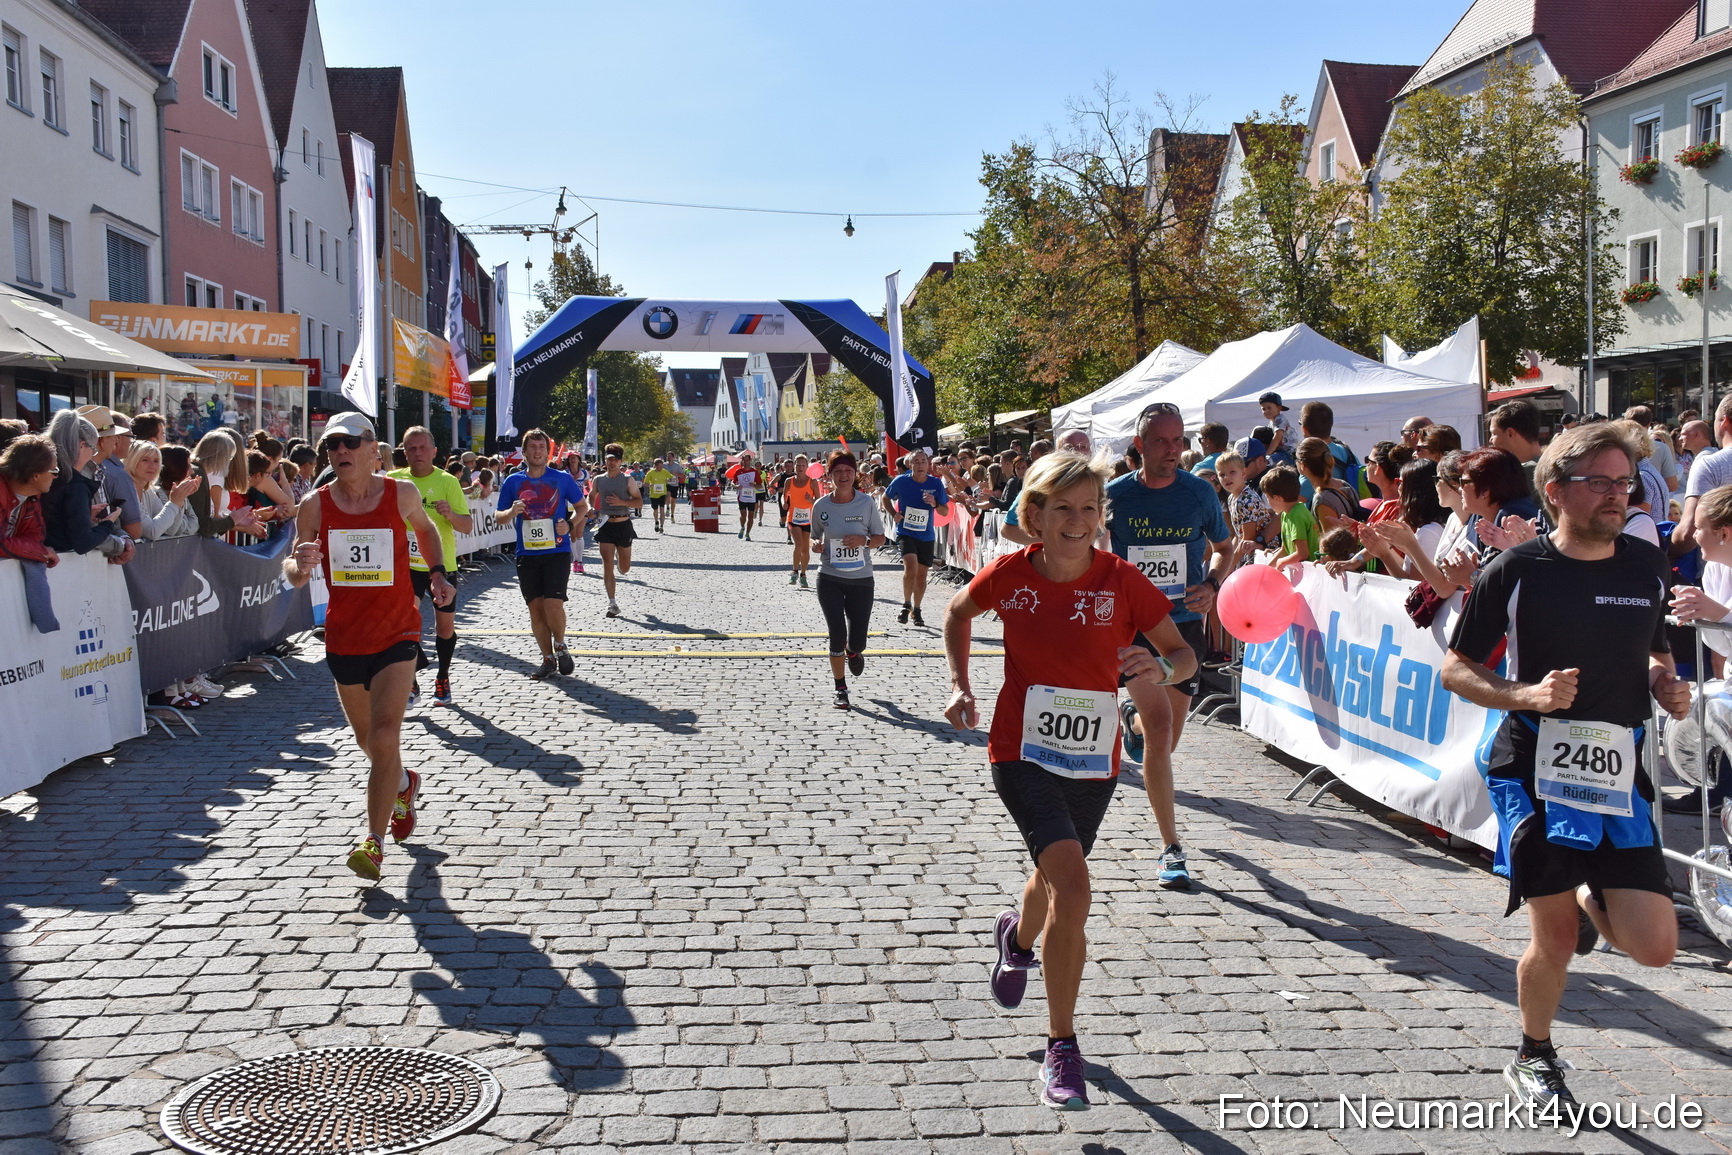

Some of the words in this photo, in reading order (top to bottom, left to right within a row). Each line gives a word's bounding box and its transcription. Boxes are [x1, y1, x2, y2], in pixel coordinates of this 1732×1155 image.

[841, 335, 869, 357] PARTL
[513, 361, 535, 377] RTL
[533, 331, 584, 366] NEUMARKT
[908, 514, 925, 522] 2313
[347, 534, 375, 542] BOCK
[531, 528, 543, 538] 98
[350, 545, 370, 563] 31
[836, 547, 859, 558] 3105
[1136, 560, 1178, 578] 2264
[345, 572, 379, 581] Bernhard
[1000, 600, 1024, 611] Spitz
[1604, 597, 1651, 607] PFLEIDERER
[131, 595, 195, 635] RAIL.ONE
[1054, 695, 1095, 708] BOCK
[1038, 711, 1101, 742] 3001
[1570, 726, 1611, 741] BOCK
[1042, 740, 1061, 749] PARTL
[1038, 751, 1088, 768] BETTINA
[1551, 742, 1622, 776] 2480
[1557, 772, 1579, 781] PARTL
[1580, 776, 1608, 785] Neumarkt
[1563, 785, 1608, 804] Rüdiger
